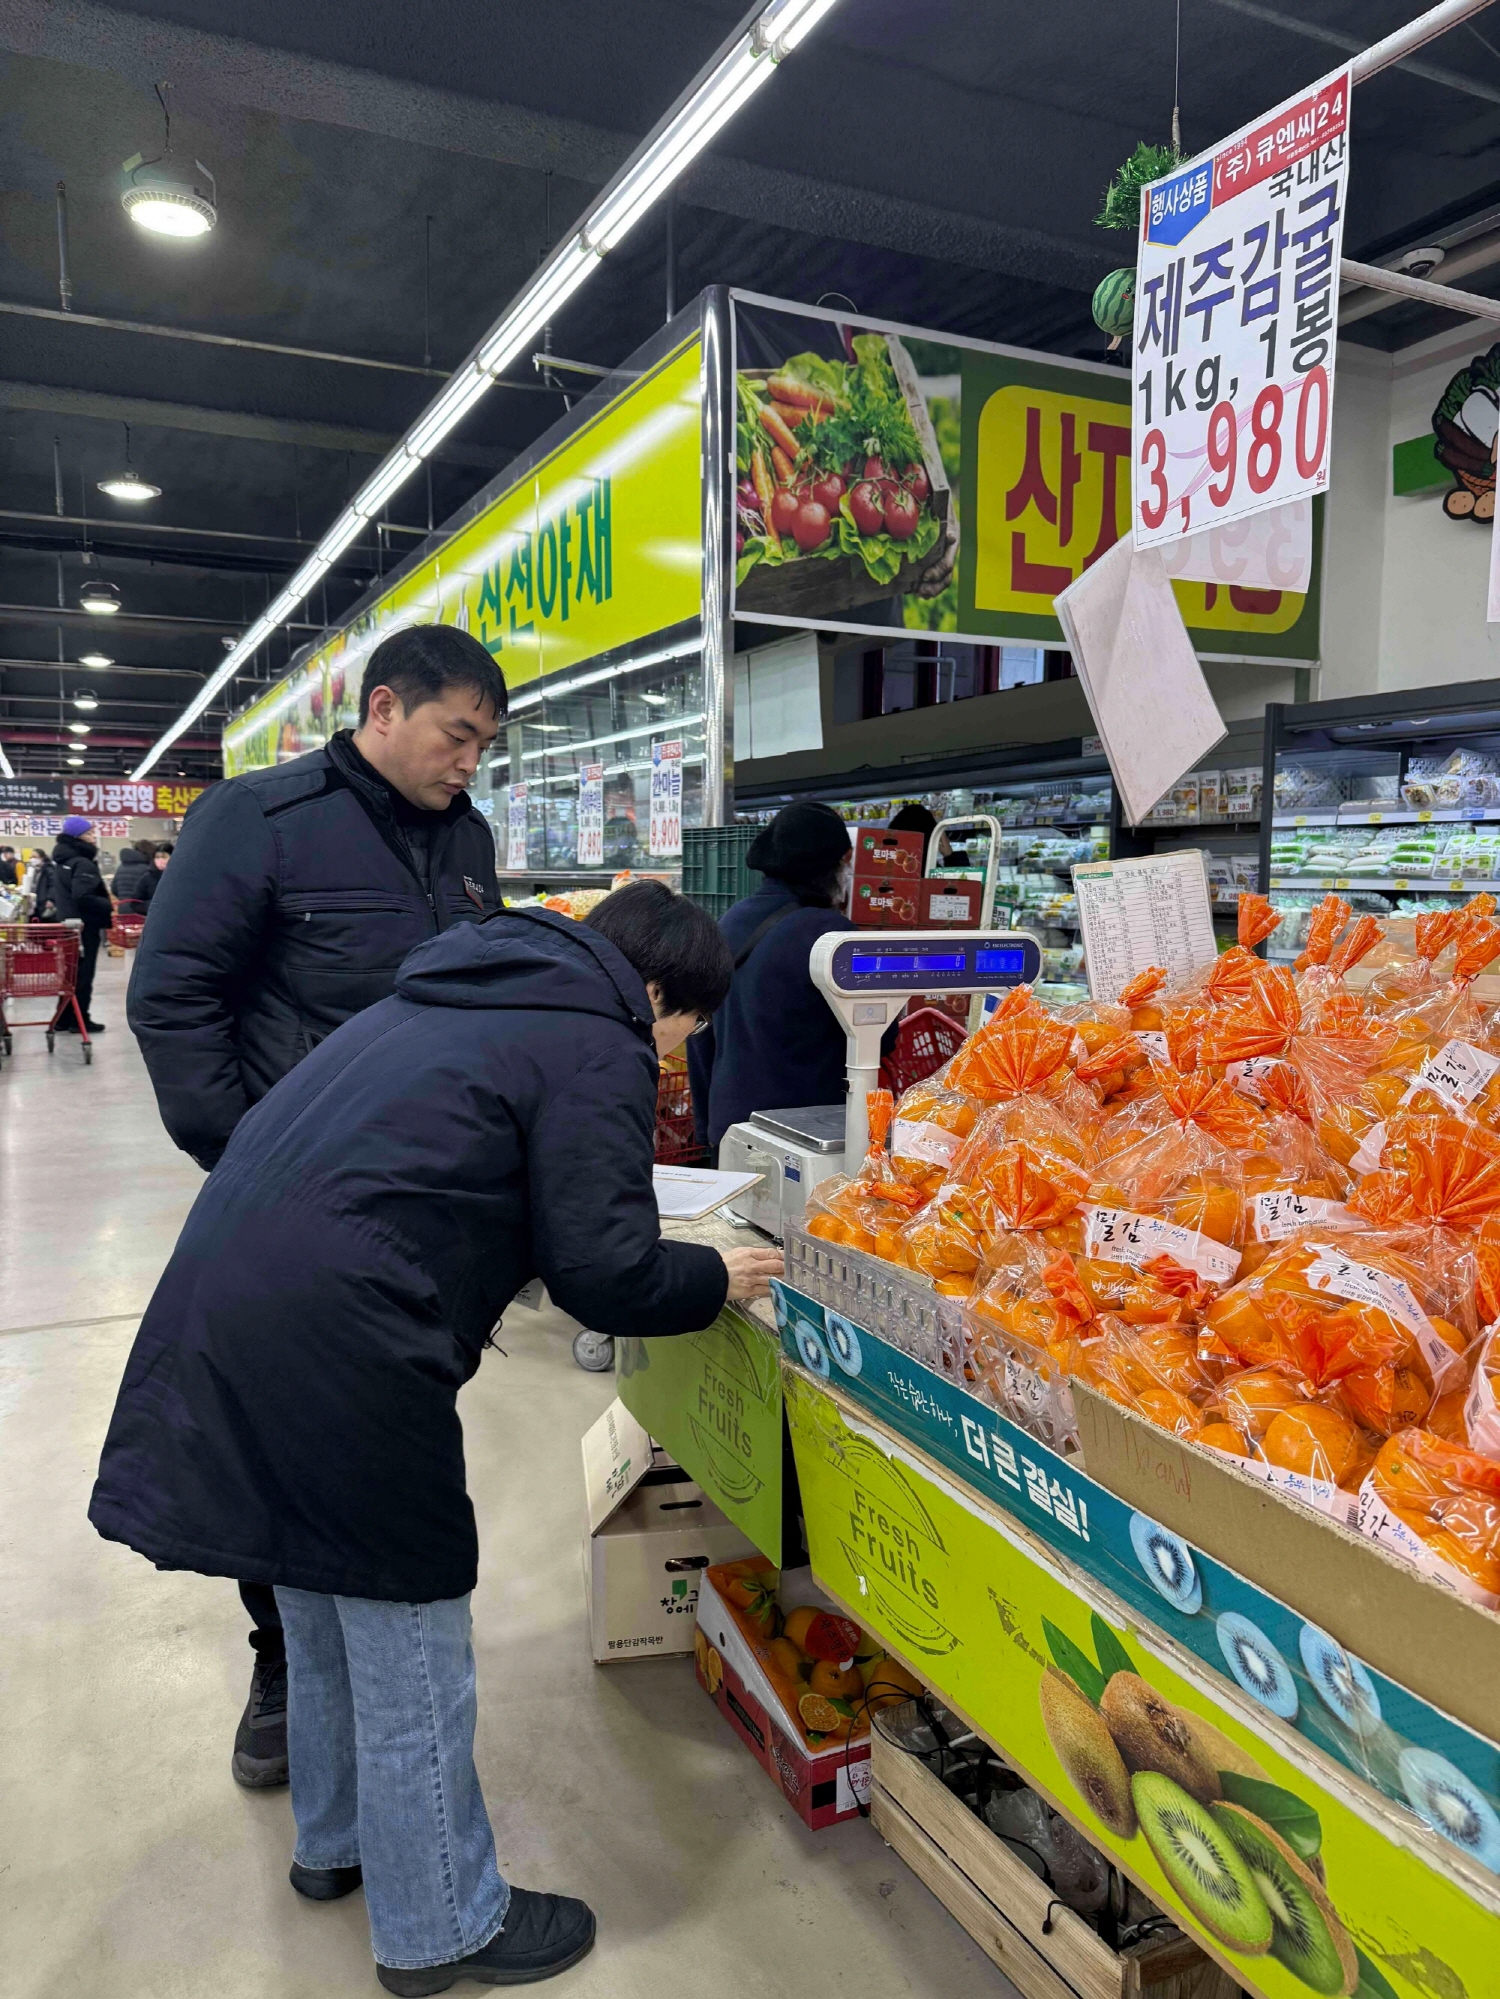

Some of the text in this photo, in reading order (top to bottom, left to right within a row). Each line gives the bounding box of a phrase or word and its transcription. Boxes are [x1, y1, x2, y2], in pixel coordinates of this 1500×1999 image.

[1216, 147, 1252, 190] (주)
[1256, 91, 1343, 166] 큐엔씨24
[1268, 132, 1346, 199] 국내산
[1152, 170, 1208, 226] 행사상품
[1138, 179, 1340, 360] 제주감귤
[1139, 302, 1334, 425] 1kg, 1봉
[1140, 365, 1329, 533] 3,980
[71, 783, 155, 812] 육가공직영
[91, 821, 129, 837] 겹살
[651, 816, 680, 853] 9,900
[872, 849, 898, 861] 토마토
[869, 896, 894, 908] 토마토
[1096, 1211, 1142, 1243] 밀감
[704, 1363, 744, 1417] Fresh
[698, 1384, 752, 1458] Fruits
[854, 1489, 921, 1562] Fresh
[849, 1510, 939, 1610] Fruits
[608, 1635, 664, 1650] 팔용단감작목반
